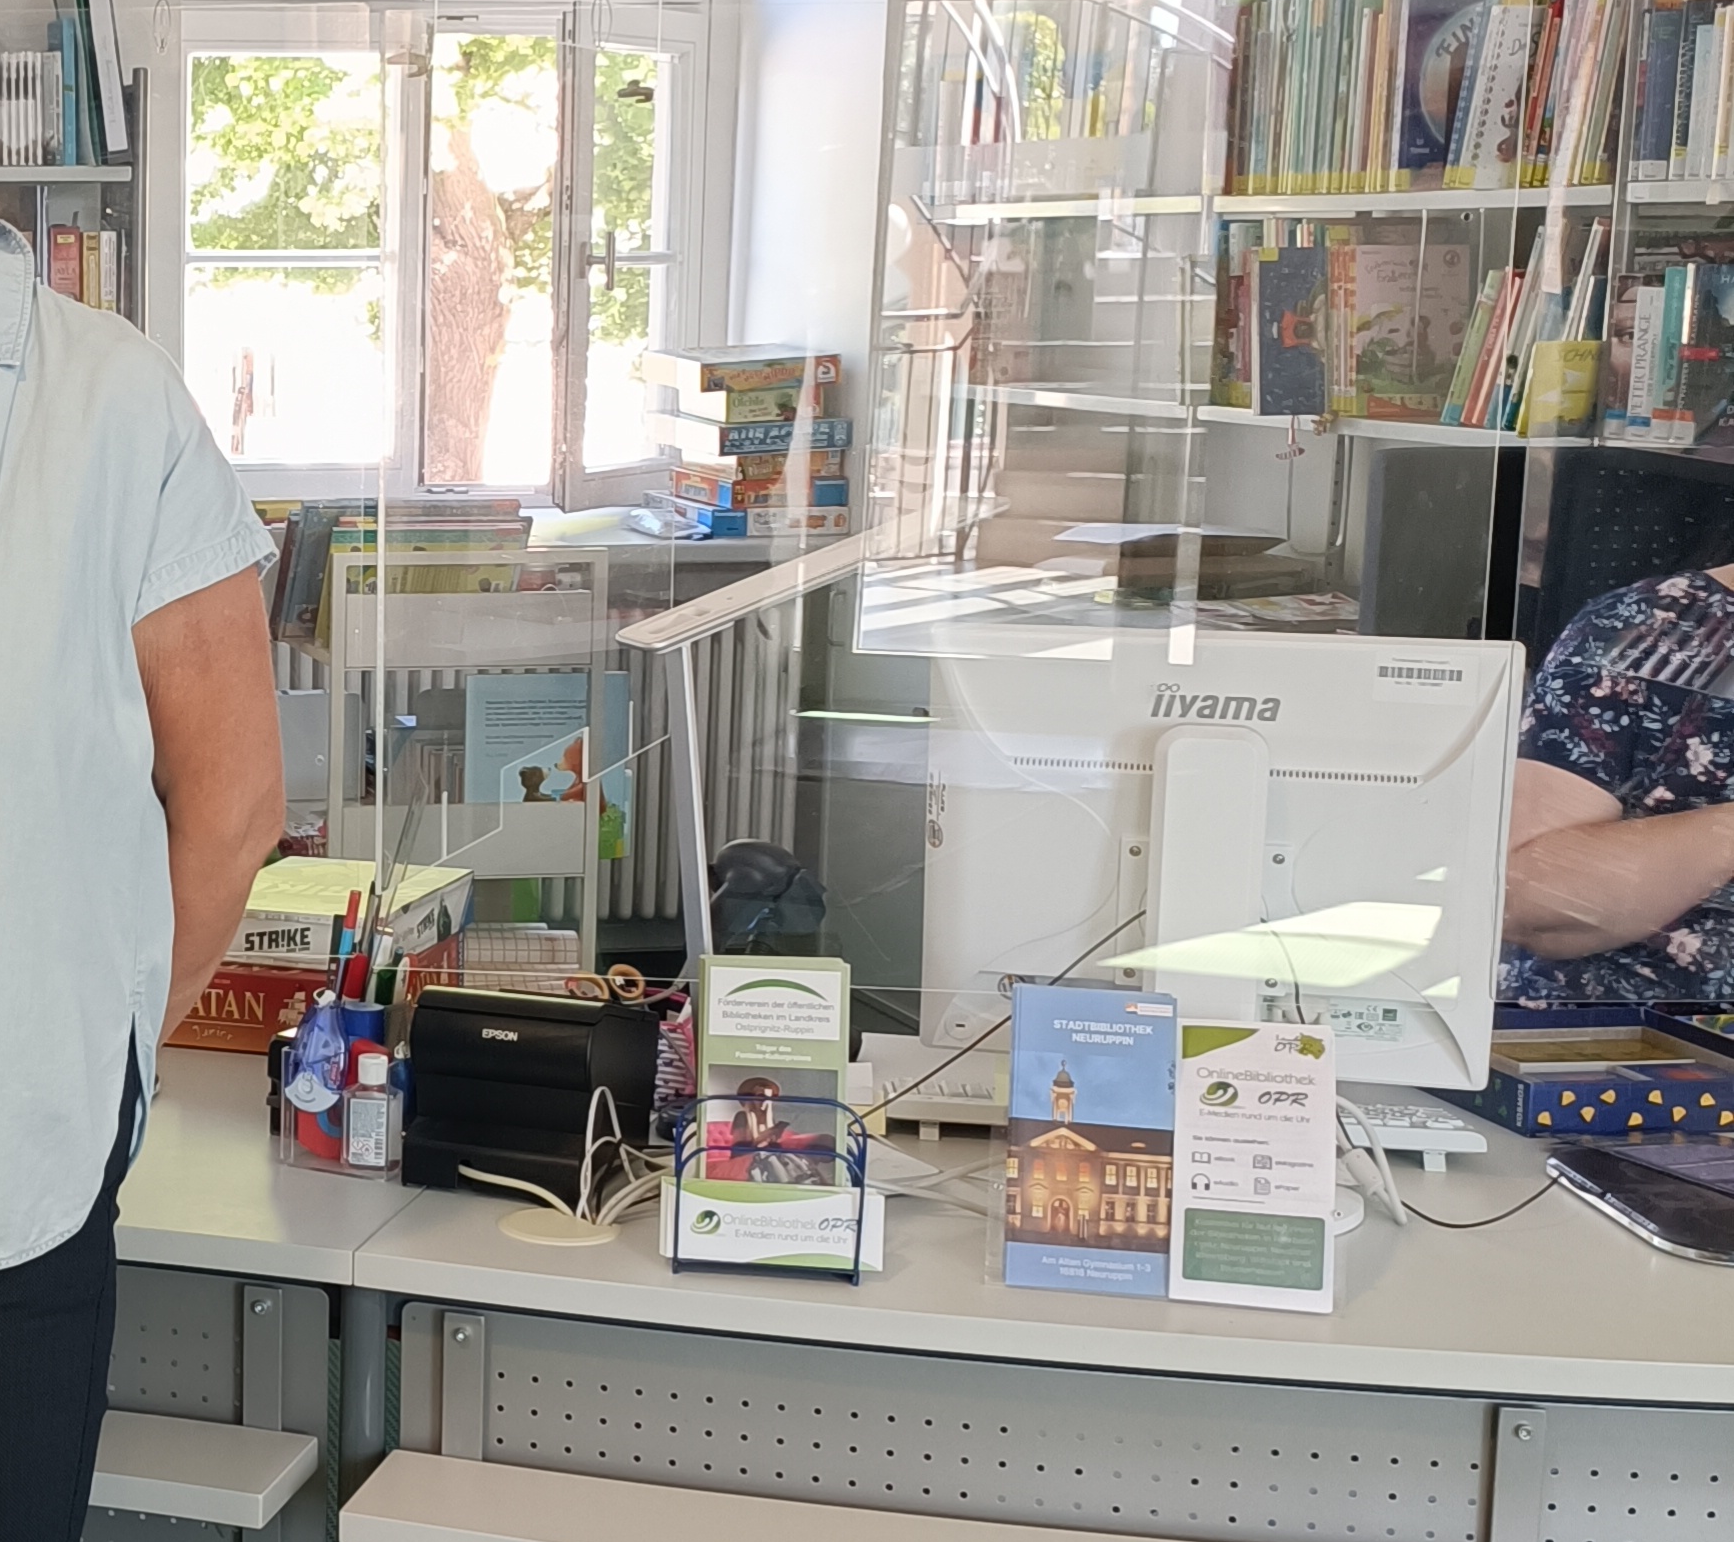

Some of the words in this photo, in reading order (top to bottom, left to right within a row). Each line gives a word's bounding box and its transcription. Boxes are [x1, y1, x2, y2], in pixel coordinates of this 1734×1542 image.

[1633, 313, 1652, 370] PRANGE
[1630, 373, 1646, 416] PETER
[1150, 683, 1282, 722] iiyama
[188, 988, 265, 1022] ATAN
[718, 997, 770, 1008] Förderverein
[771, 1000, 785, 1008] der
[787, 1000, 835, 1011] öffentlichen
[722, 1010, 774, 1021] Bibliotheken
[788, 1014, 831, 1024] Landkreis
[482, 1028, 518, 1042] EPSON
[735, 1022, 814, 1035] Ostprignitz-Ruppin
[1053, 1019, 1153, 1035] STADTBIBLIOTHEK
[1072, 1033, 1134, 1045] NEURUPPIN
[1196, 1067, 1316, 1086] OnlineBibliothek
[1258, 1091, 1309, 1107] OPR
[1516, 1083, 1524, 1127] KOSMOS
[1199, 1108, 1239, 1119] E-Medien
[1241, 1110, 1262, 1121] rund
[1264, 1113, 1278, 1121] um
[1279, 1112, 1294, 1122] die
[1295, 1114, 1311, 1123] Uhr
[722, 1213, 817, 1230] OnlineBibliothek
[818, 1218, 859, 1232] OPR
[734, 1229, 776, 1240] E-Medien
[777, 1231, 799, 1242] rund
[800, 1234, 814, 1242] um
[816, 1233, 831, 1244] die
[833, 1235, 848, 1245] Uhr
[1042, 1256, 1056, 1265] Am
[1136, 1263, 1151, 1273] 1-3
